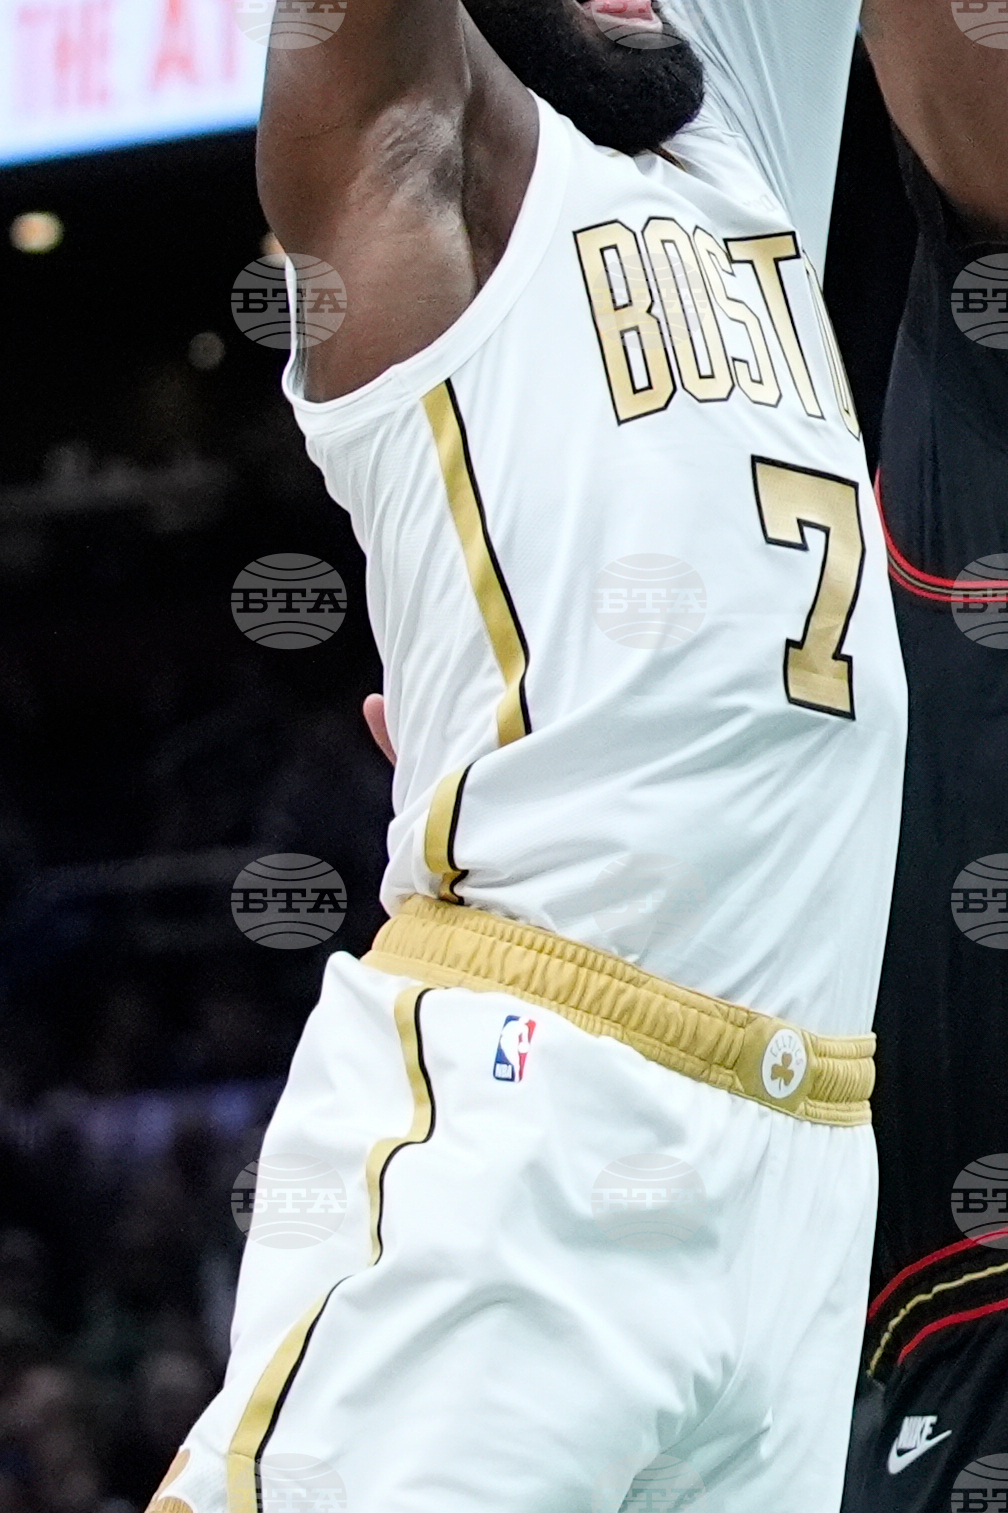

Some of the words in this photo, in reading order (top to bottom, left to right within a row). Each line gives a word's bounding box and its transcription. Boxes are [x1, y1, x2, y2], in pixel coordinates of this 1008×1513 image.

[573, 216, 862, 441] BOSTO
[751, 454, 866, 720] 7
[897, 1415, 939, 1449] NIKE
